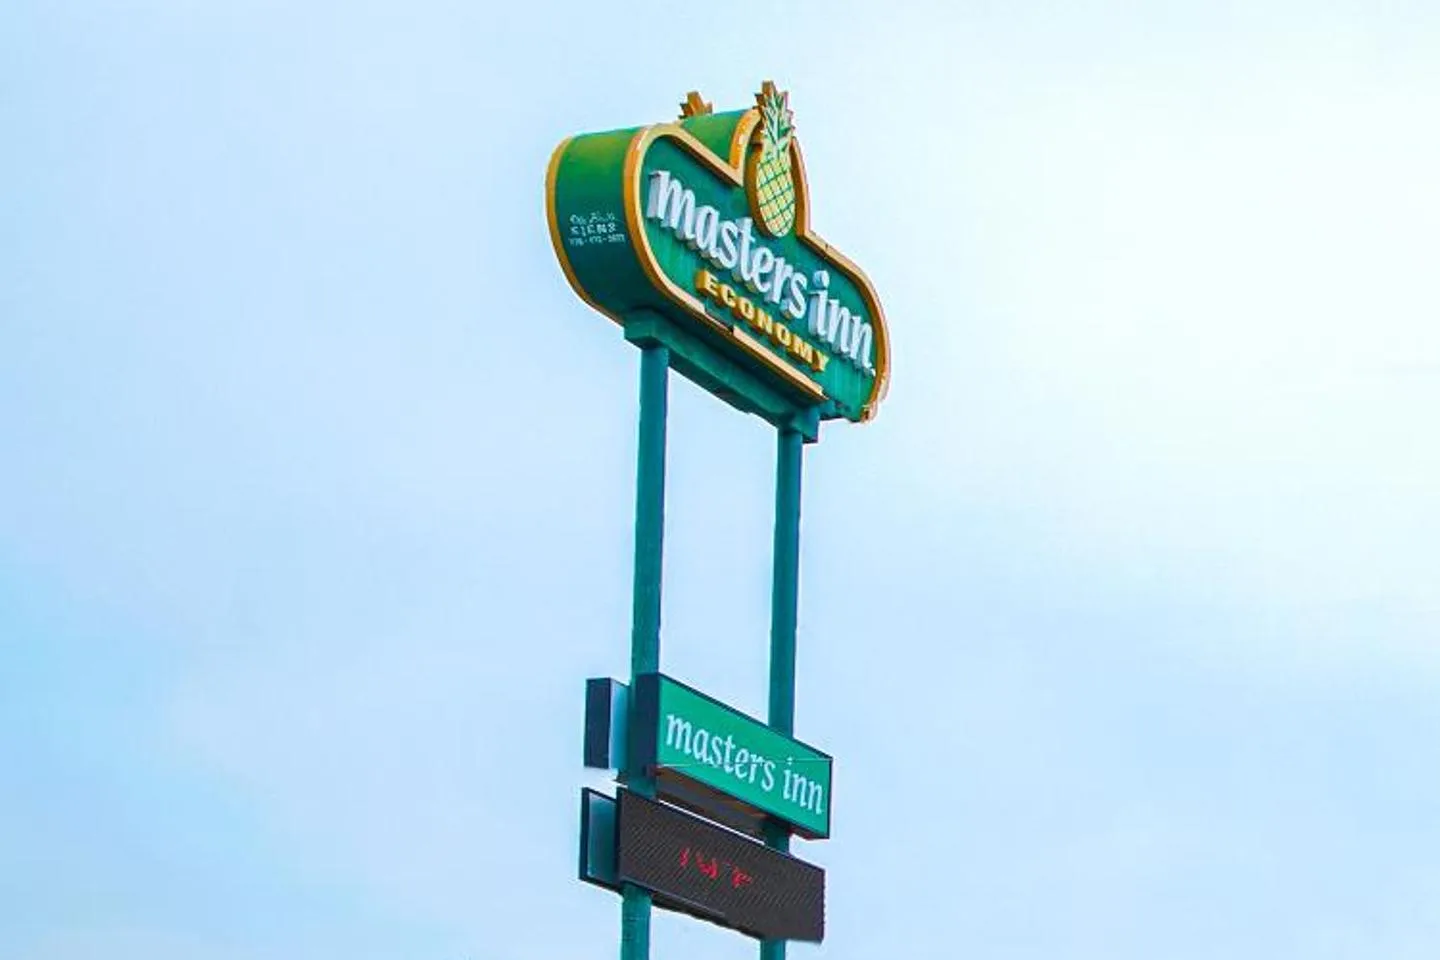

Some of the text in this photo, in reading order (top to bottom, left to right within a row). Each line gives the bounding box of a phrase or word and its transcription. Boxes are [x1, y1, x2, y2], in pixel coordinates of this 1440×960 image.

[647, 170, 807, 319] masters
[696, 270, 830, 373] ECONOMY
[666, 713, 823, 815] masters inn
